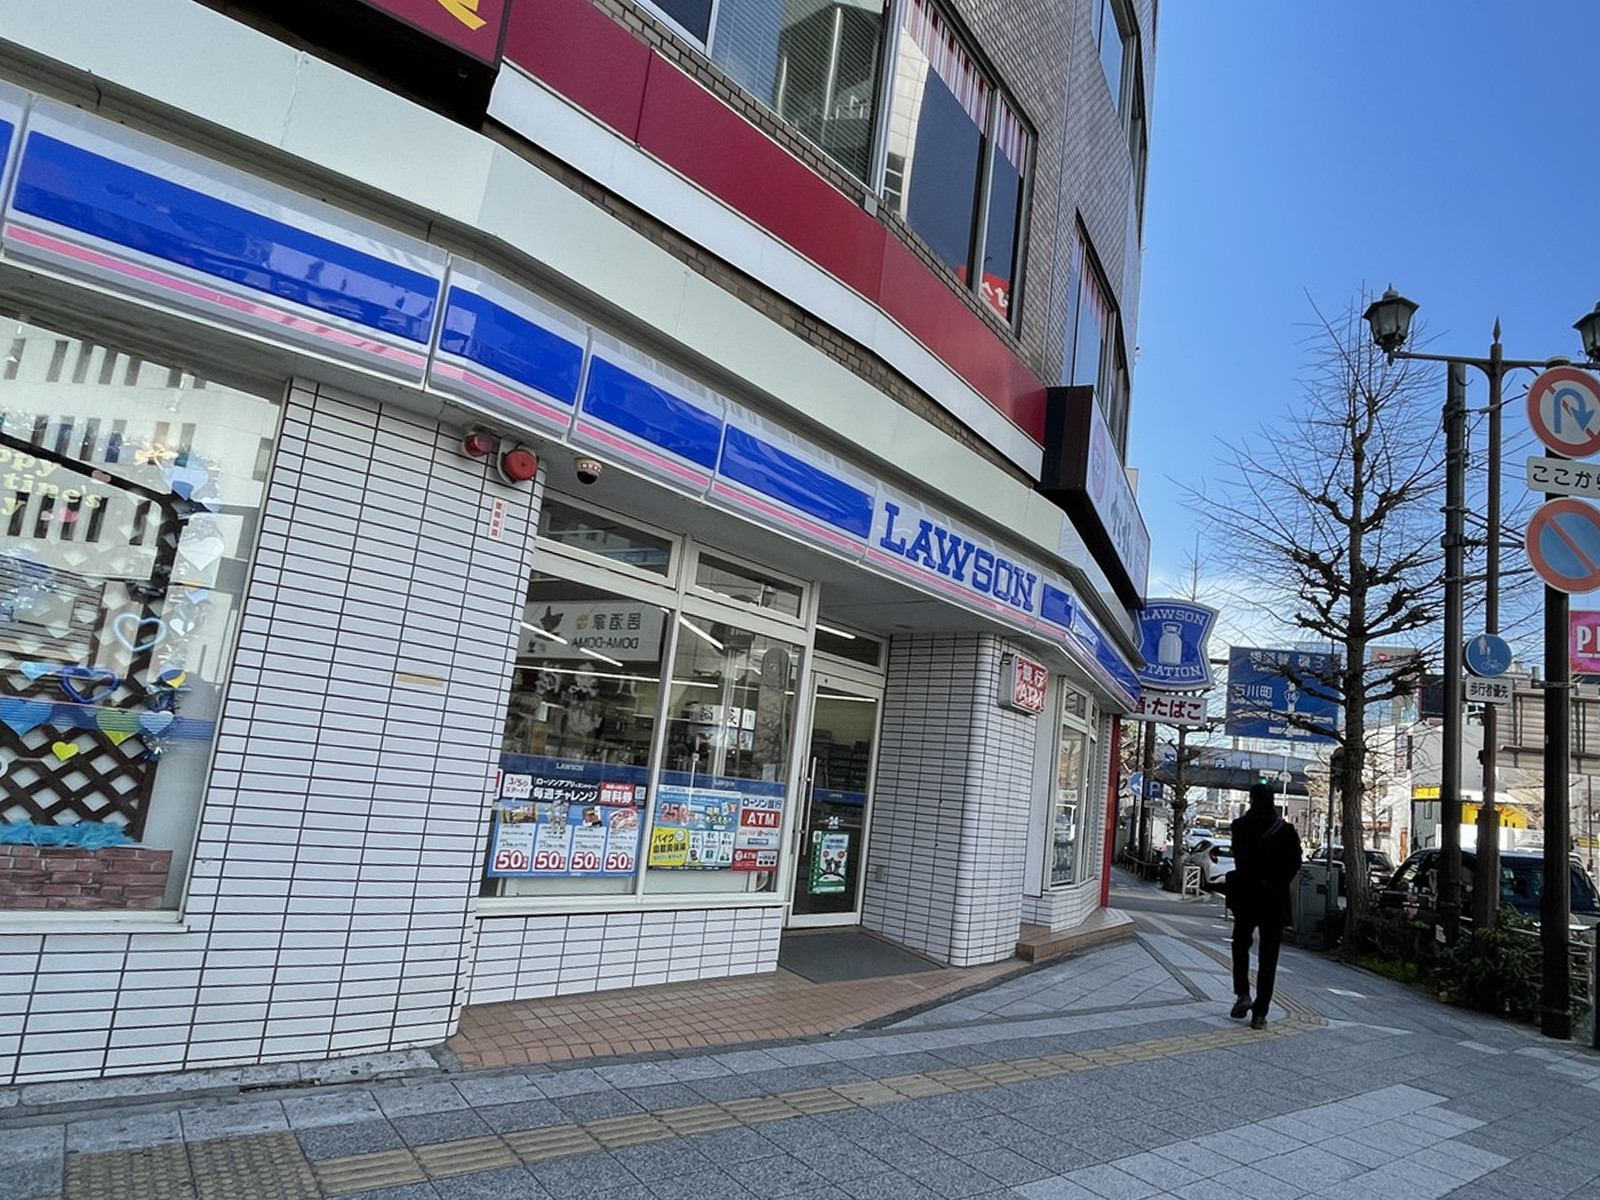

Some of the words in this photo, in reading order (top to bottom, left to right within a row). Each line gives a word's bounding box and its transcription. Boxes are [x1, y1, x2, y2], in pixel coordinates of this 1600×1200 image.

[1533, 464, 1600, 490] ここか
[879, 501, 1037, 612] LAWSON
[1141, 609, 1206, 626] LAWSON
[1139, 662, 1201, 677] TATION
[1233, 683, 1272, 699] 石川町
[1470, 681, 1509, 699] 歩行者優先
[533, 787, 598, 802] 毎週チャレンジ
[1150, 781, 1161, 795] P
[600, 789, 633, 804] 無料券
[742, 798, 782, 809] ローソン銀行
[747, 811, 775, 827] ATM
[655, 833, 674, 843] バイク
